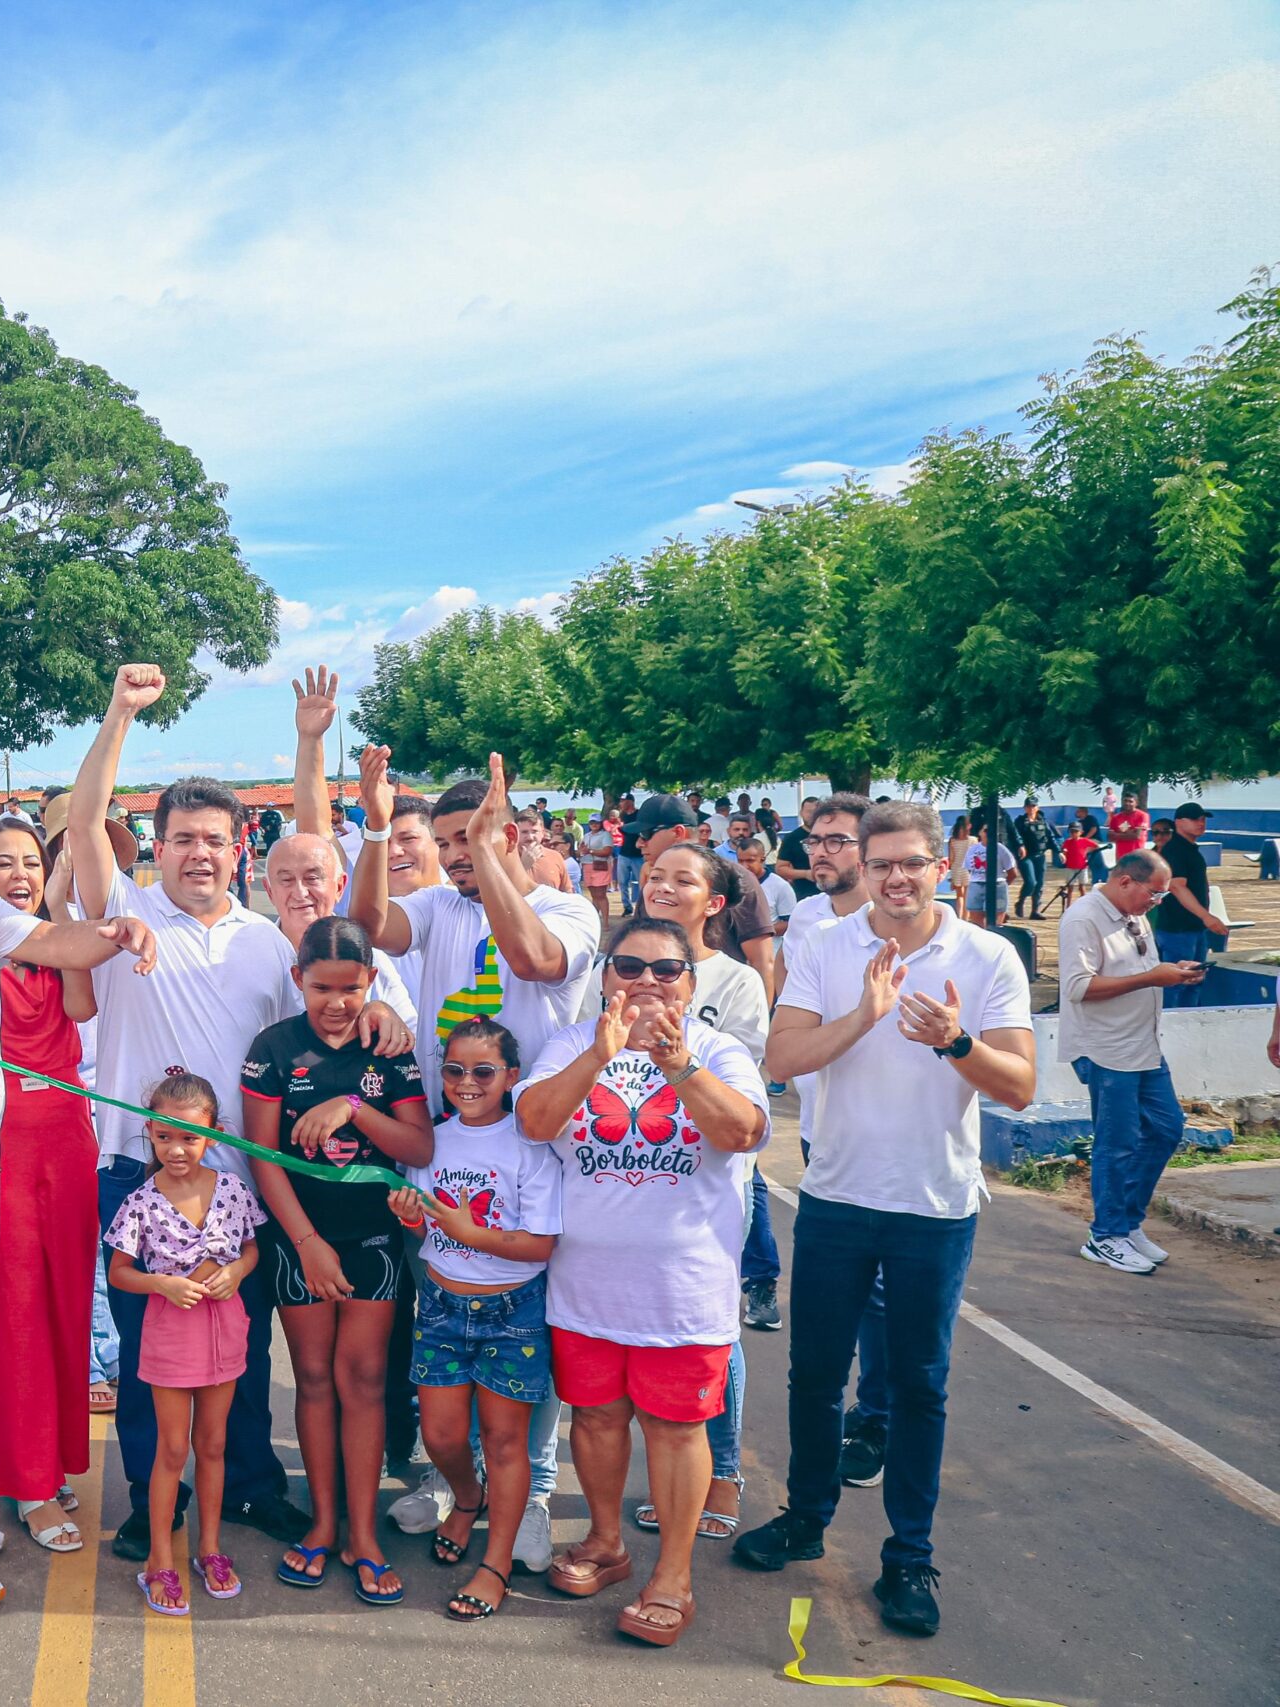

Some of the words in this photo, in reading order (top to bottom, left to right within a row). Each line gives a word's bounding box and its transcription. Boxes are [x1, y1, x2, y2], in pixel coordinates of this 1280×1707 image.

[604, 1059, 665, 1082] migo
[626, 1078, 645, 1090] da
[576, 1145, 699, 1176] Borboleta
[438, 1167, 490, 1187] Amigos
[1099, 1243, 1125, 1260] FILA
